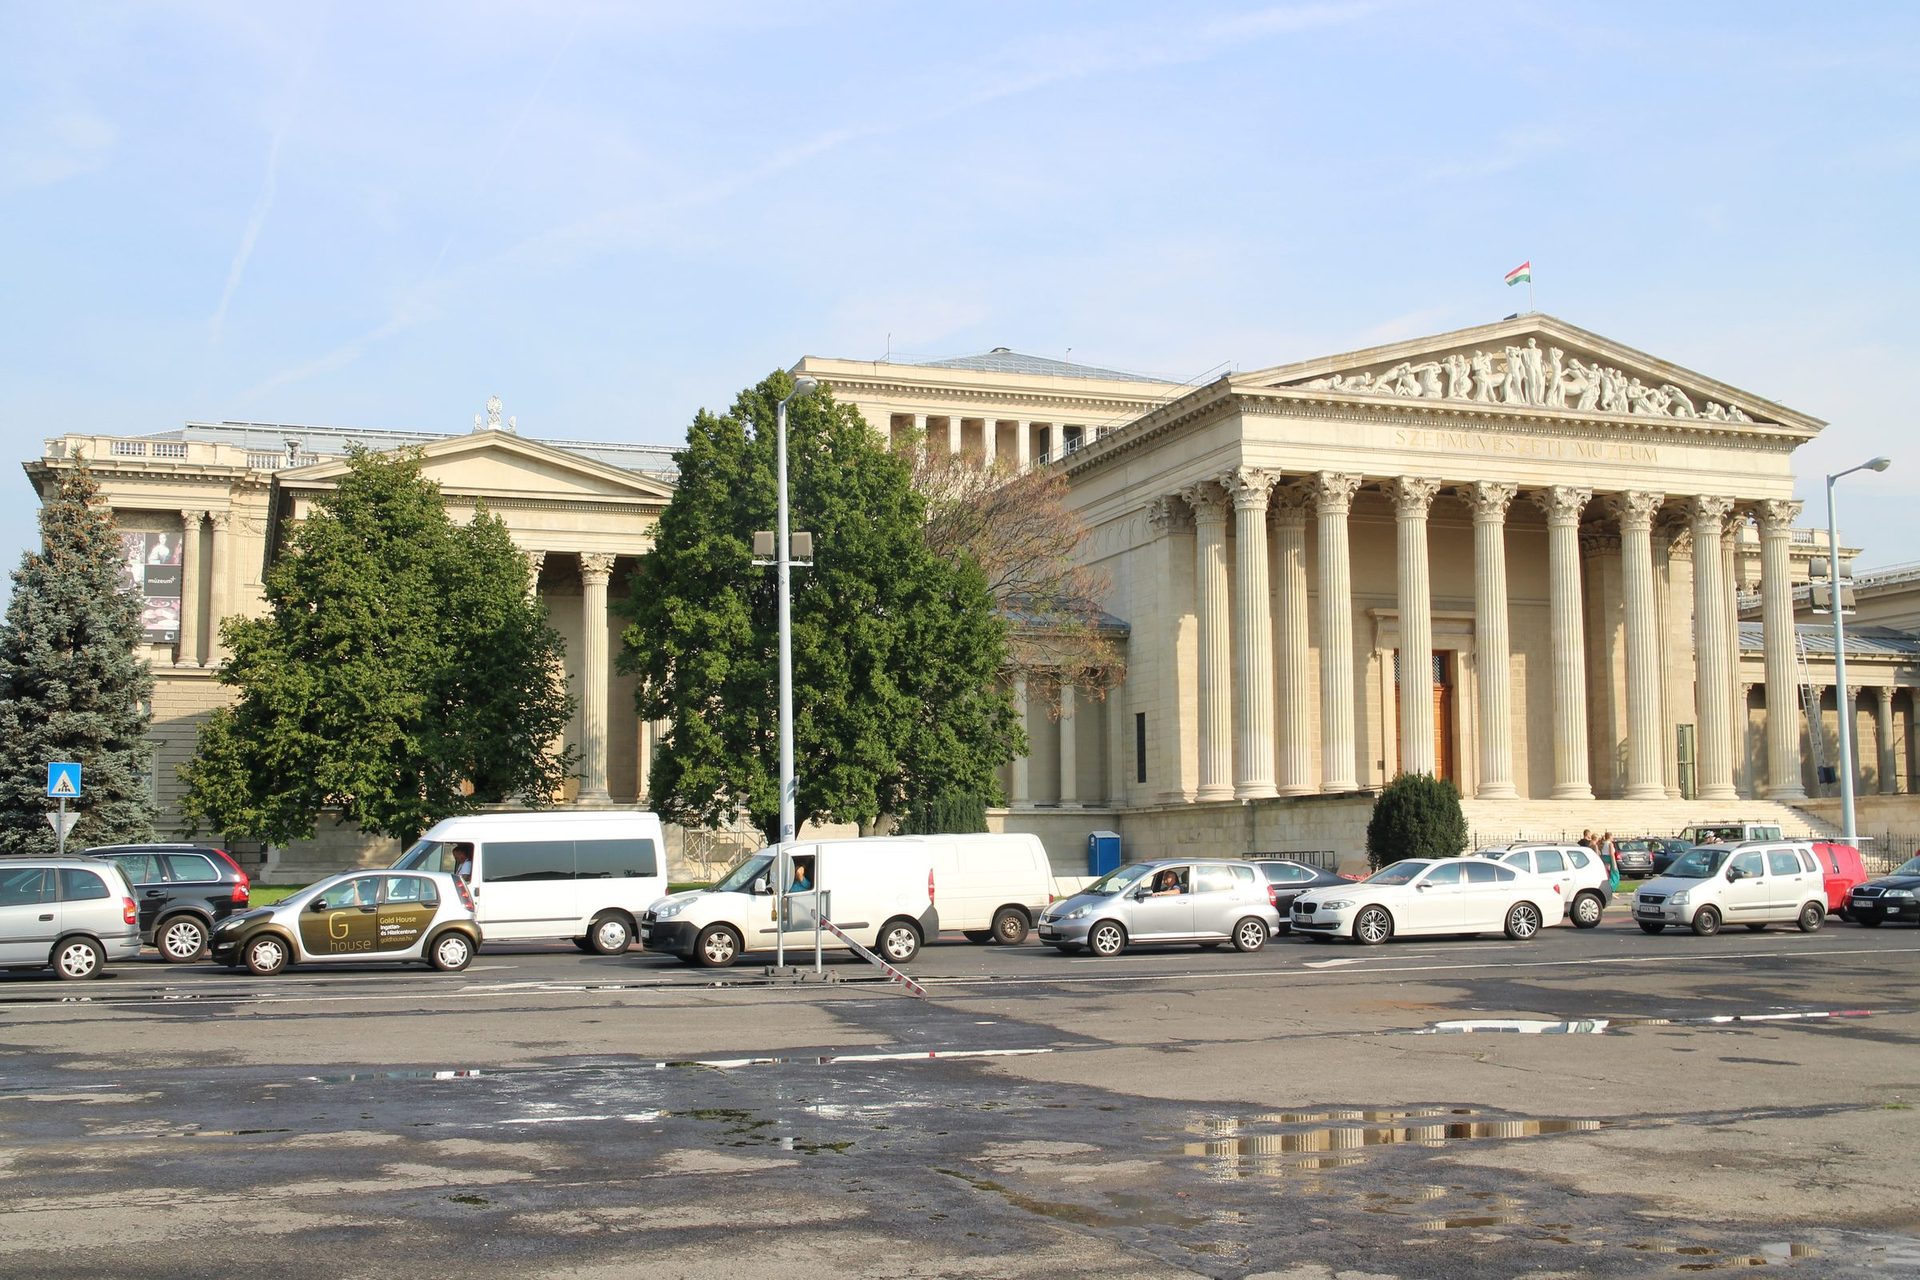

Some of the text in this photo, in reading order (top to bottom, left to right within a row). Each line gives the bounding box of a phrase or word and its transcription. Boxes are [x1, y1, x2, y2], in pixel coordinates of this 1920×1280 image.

[329, 911, 349, 939] G
[380, 916, 417, 925] Gold House
[330, 940, 372, 952] house
